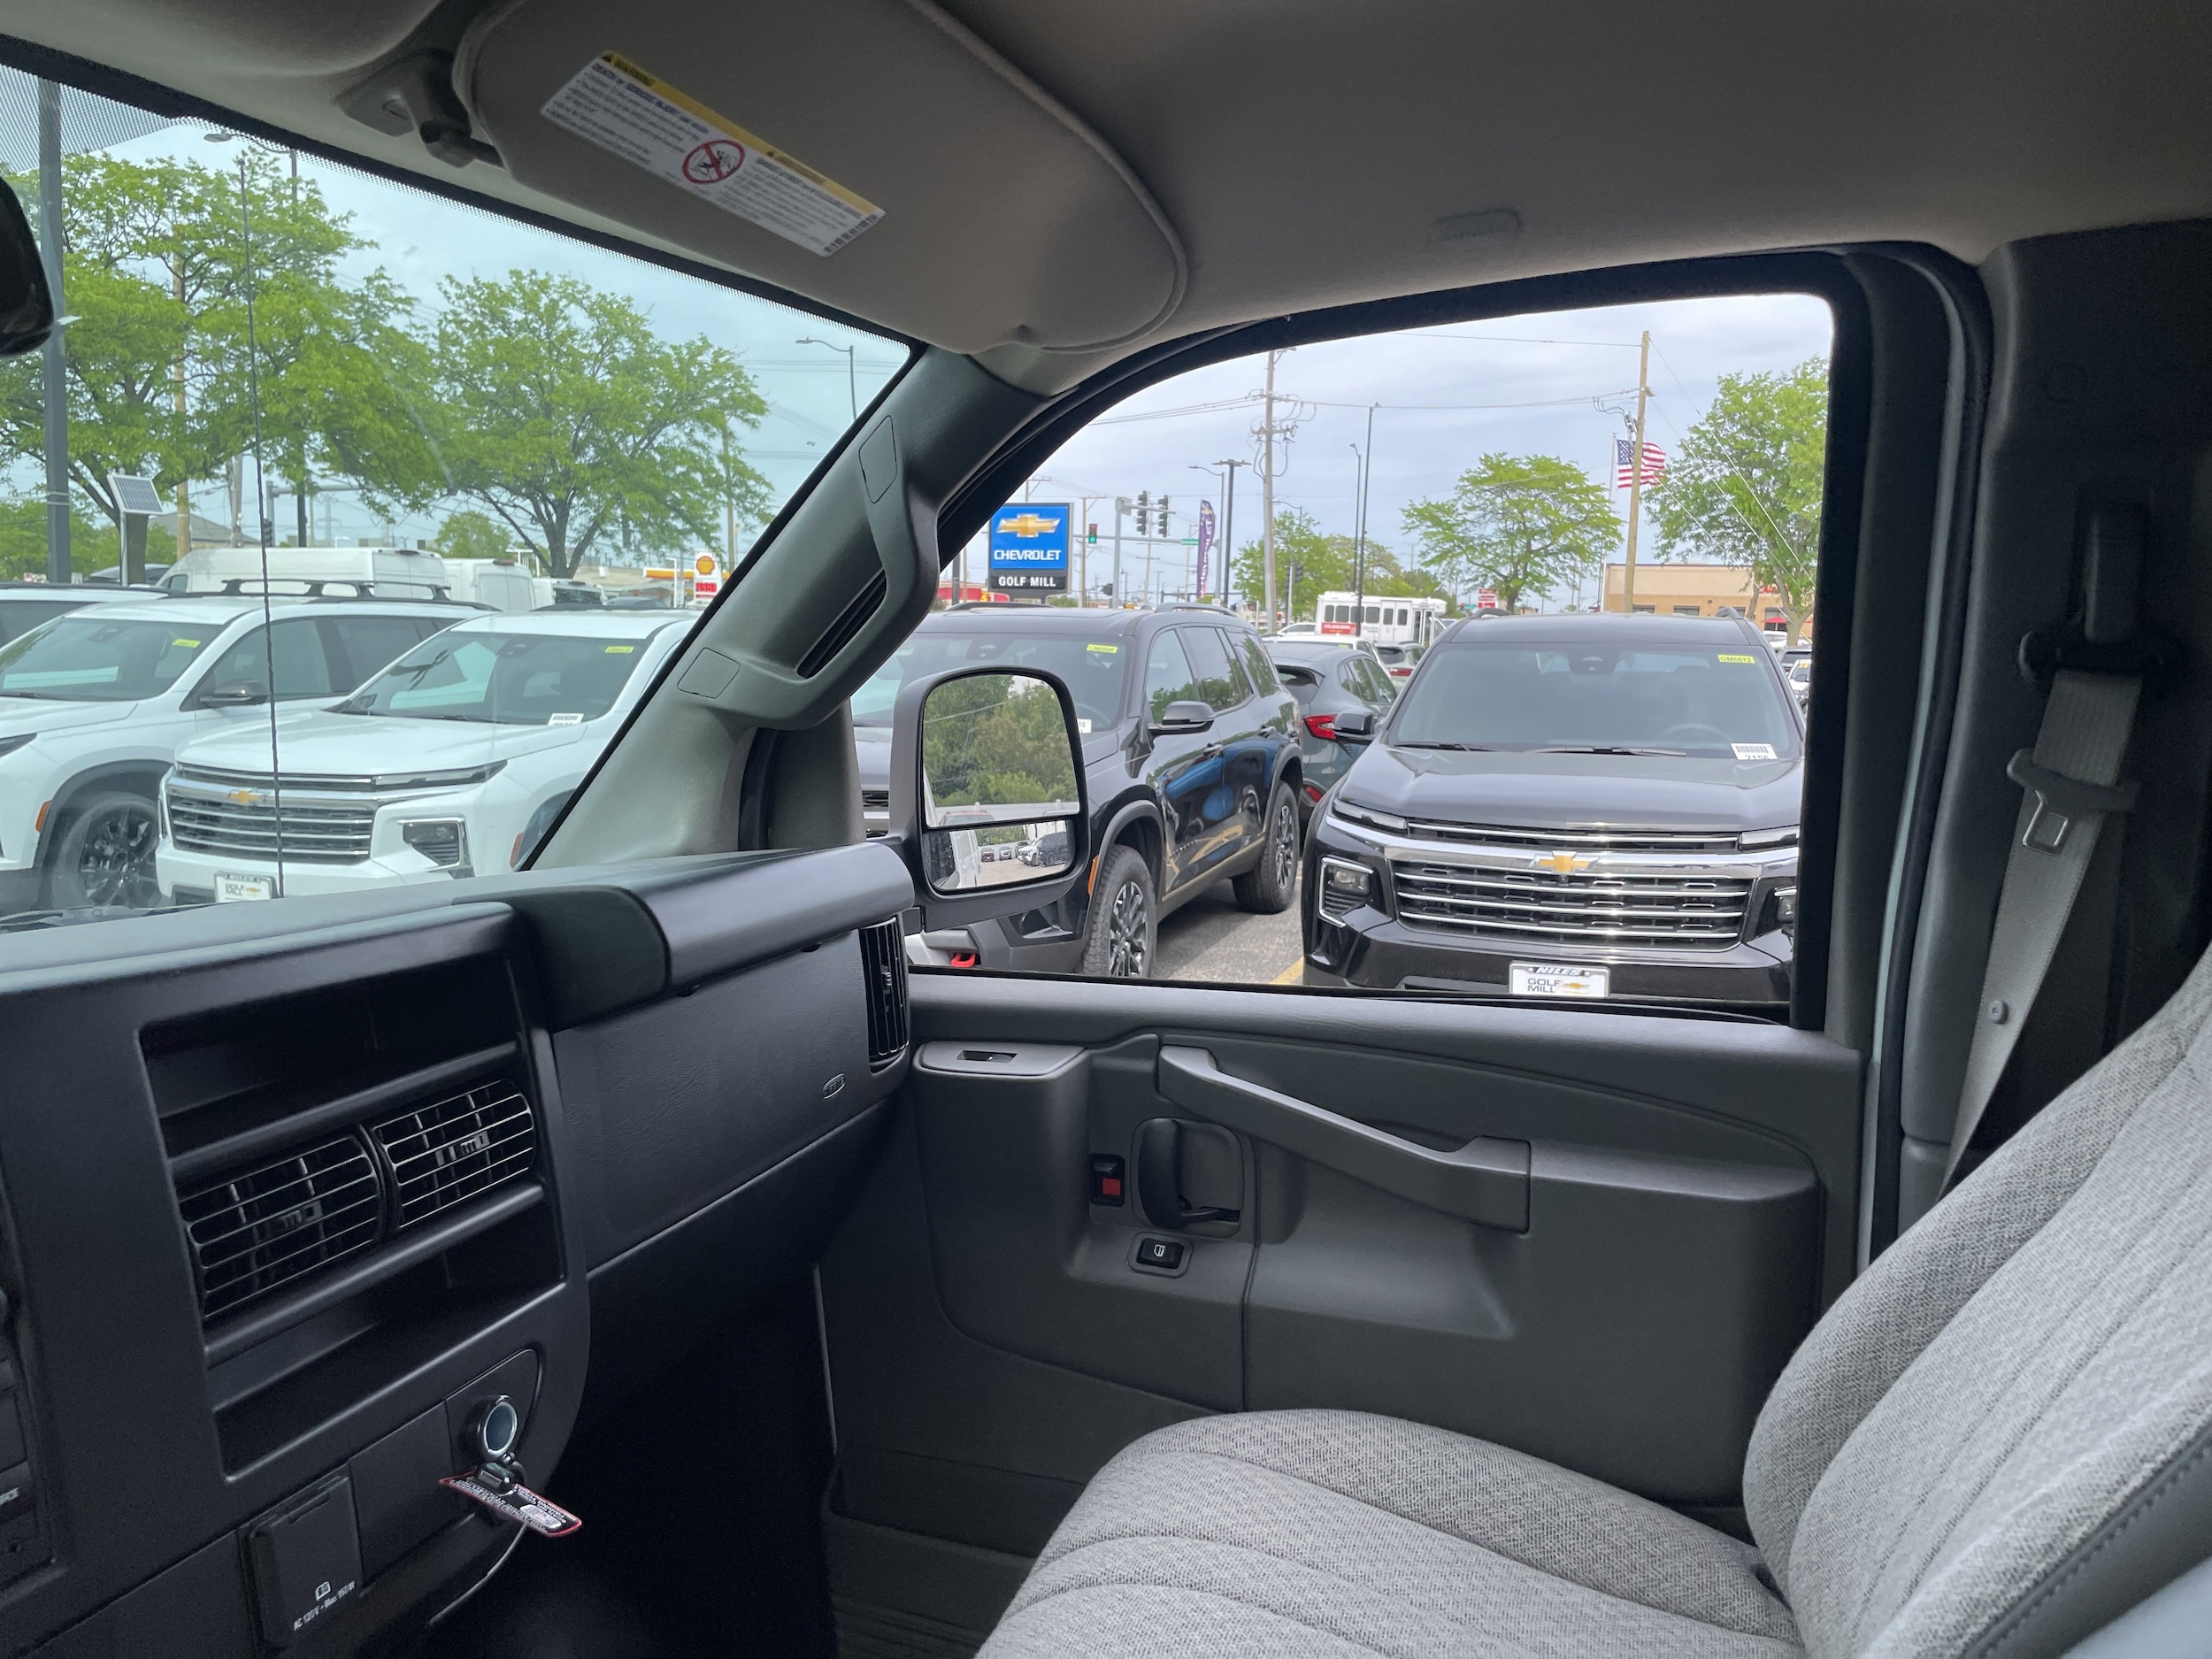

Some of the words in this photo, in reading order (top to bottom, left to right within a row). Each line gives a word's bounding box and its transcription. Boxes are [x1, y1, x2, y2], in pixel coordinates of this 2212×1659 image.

[994, 549, 1062, 561] CHEVROLET
[998, 576, 1026, 587] GOLF
[1030, 577, 1056, 587] MILL
[1535, 966, 1581, 976] NILES
[1528, 978, 1560, 987] GOLF
[1528, 985, 1555, 994] MILL
